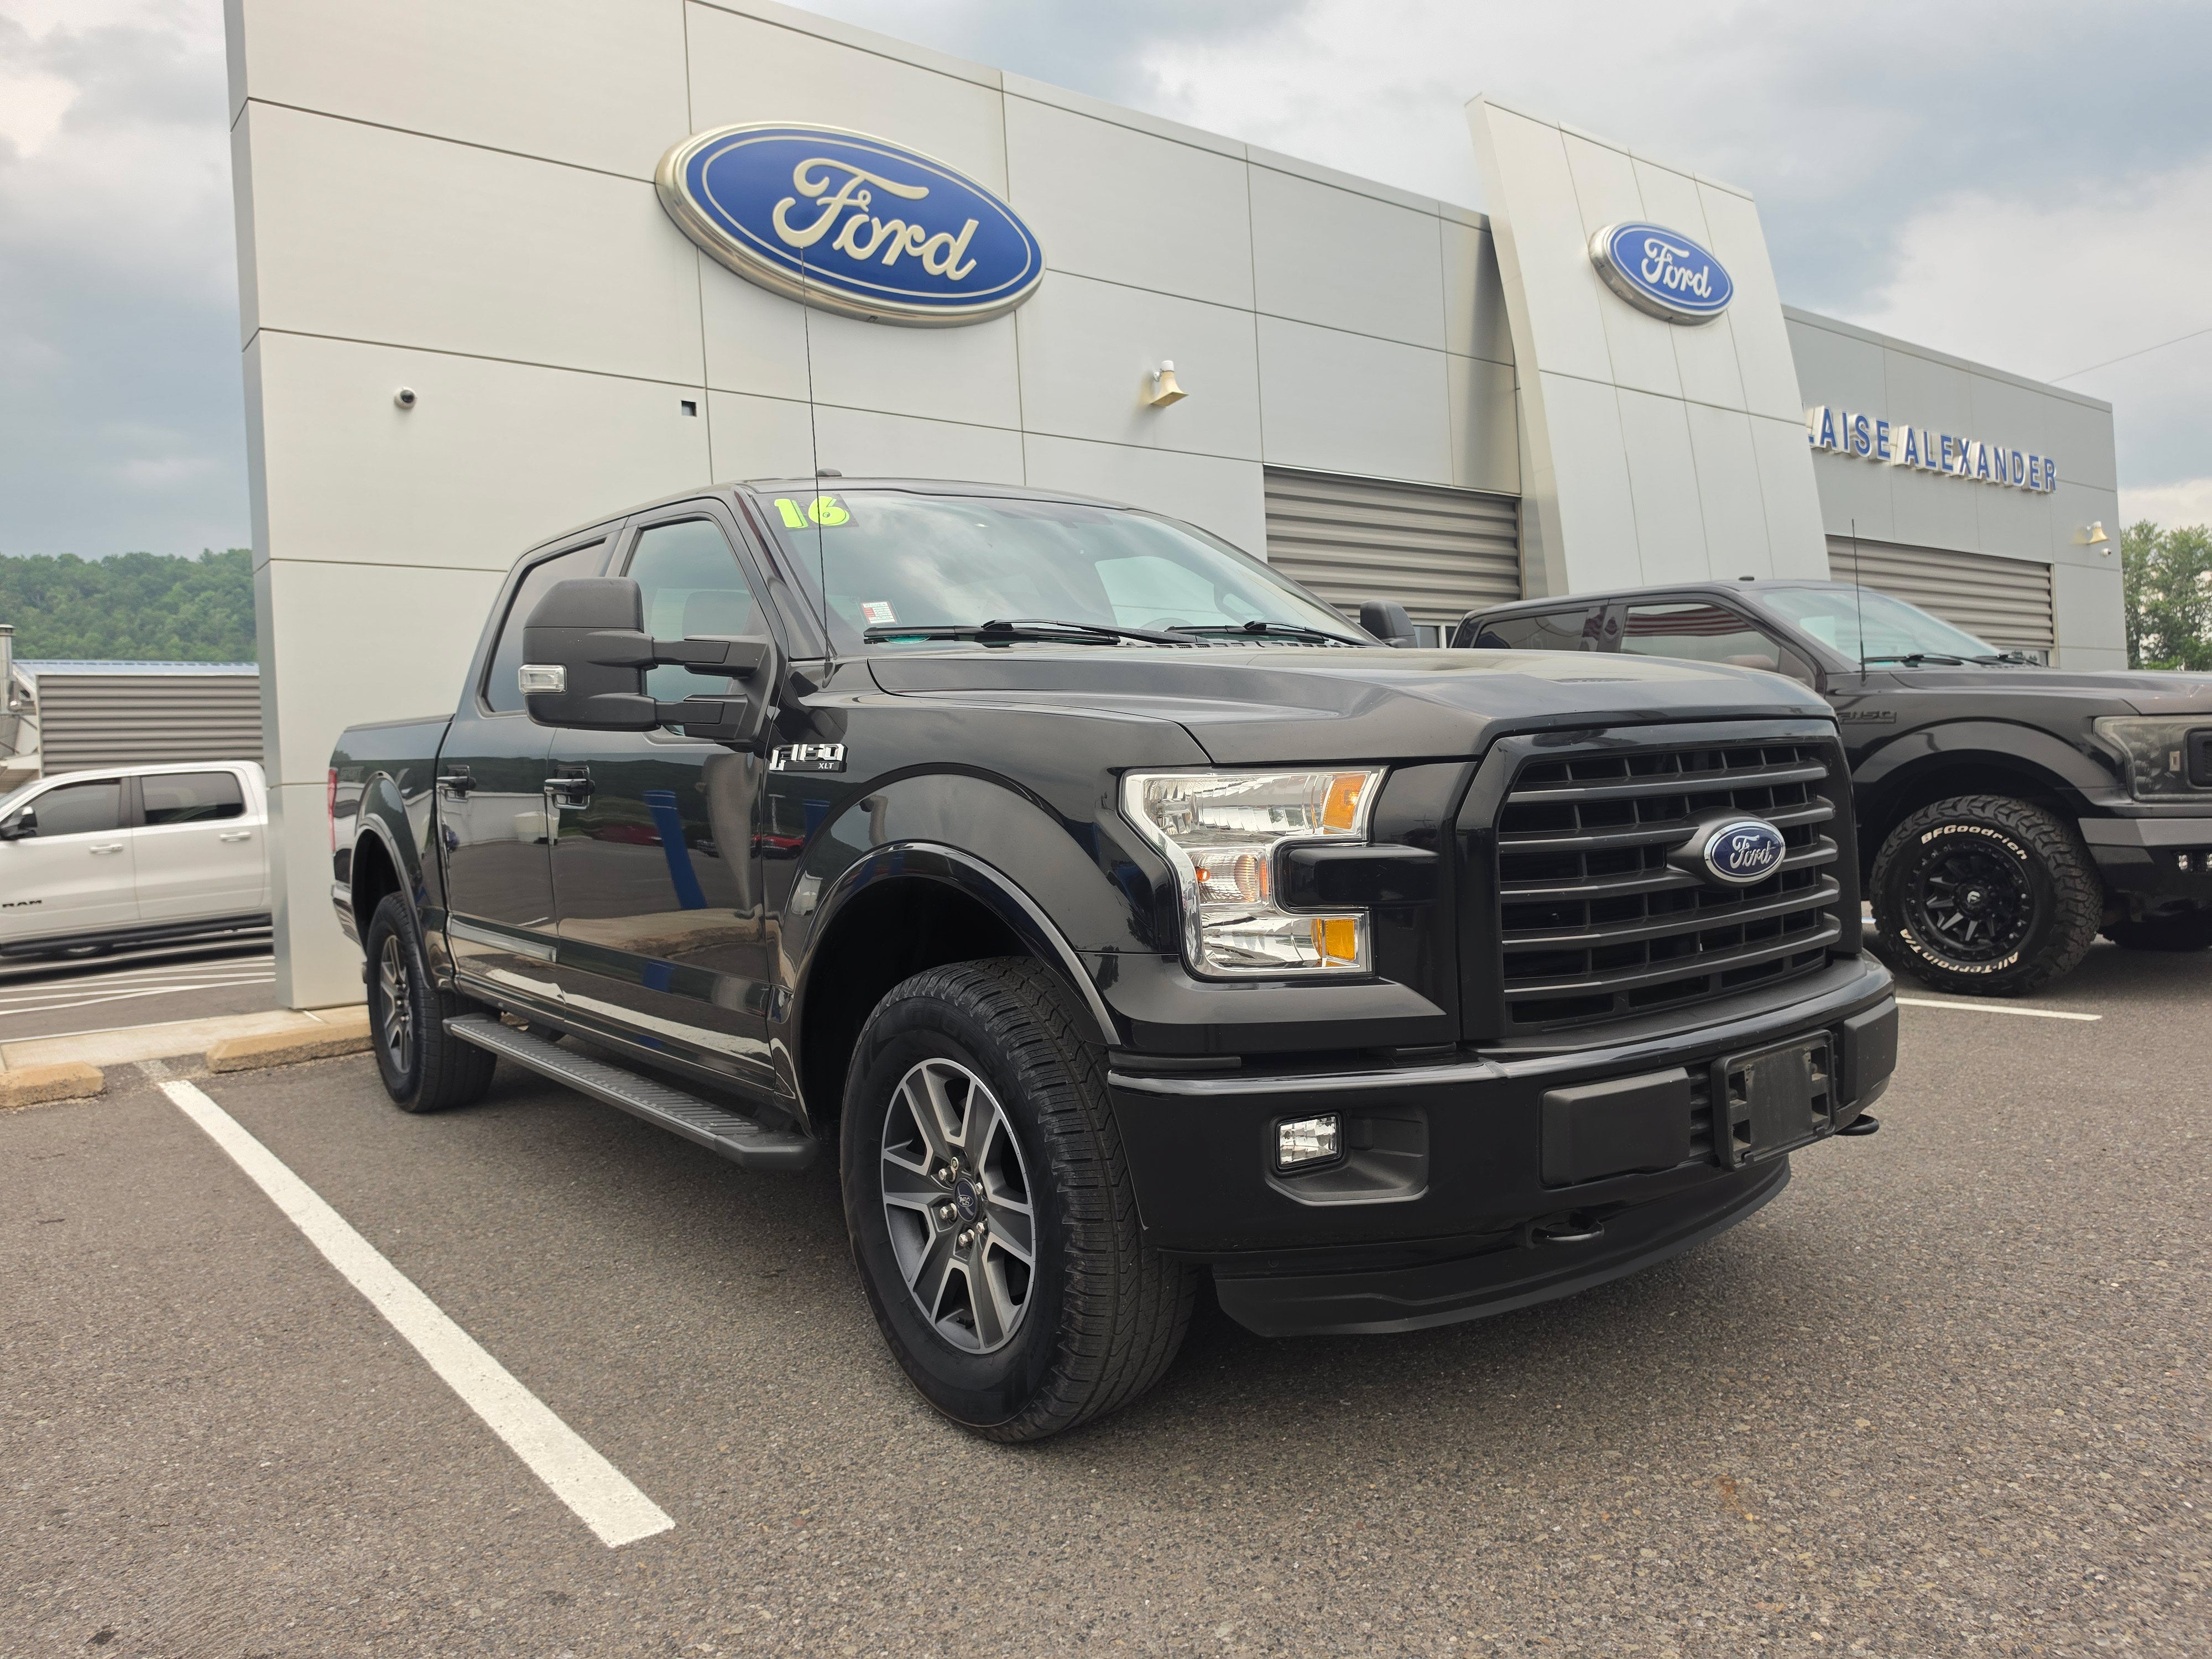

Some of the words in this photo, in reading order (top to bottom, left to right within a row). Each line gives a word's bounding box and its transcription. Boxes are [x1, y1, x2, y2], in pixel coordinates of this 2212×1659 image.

[773, 158, 979, 280] Ford
[1641, 237, 1712, 299] Ford
[1903, 425, 2057, 493] ALEXANDER
[774, 495, 850, 529] 16
[1730, 834, 1773, 869] Ford
[1921, 825, 2027, 860] BFGoodrich
